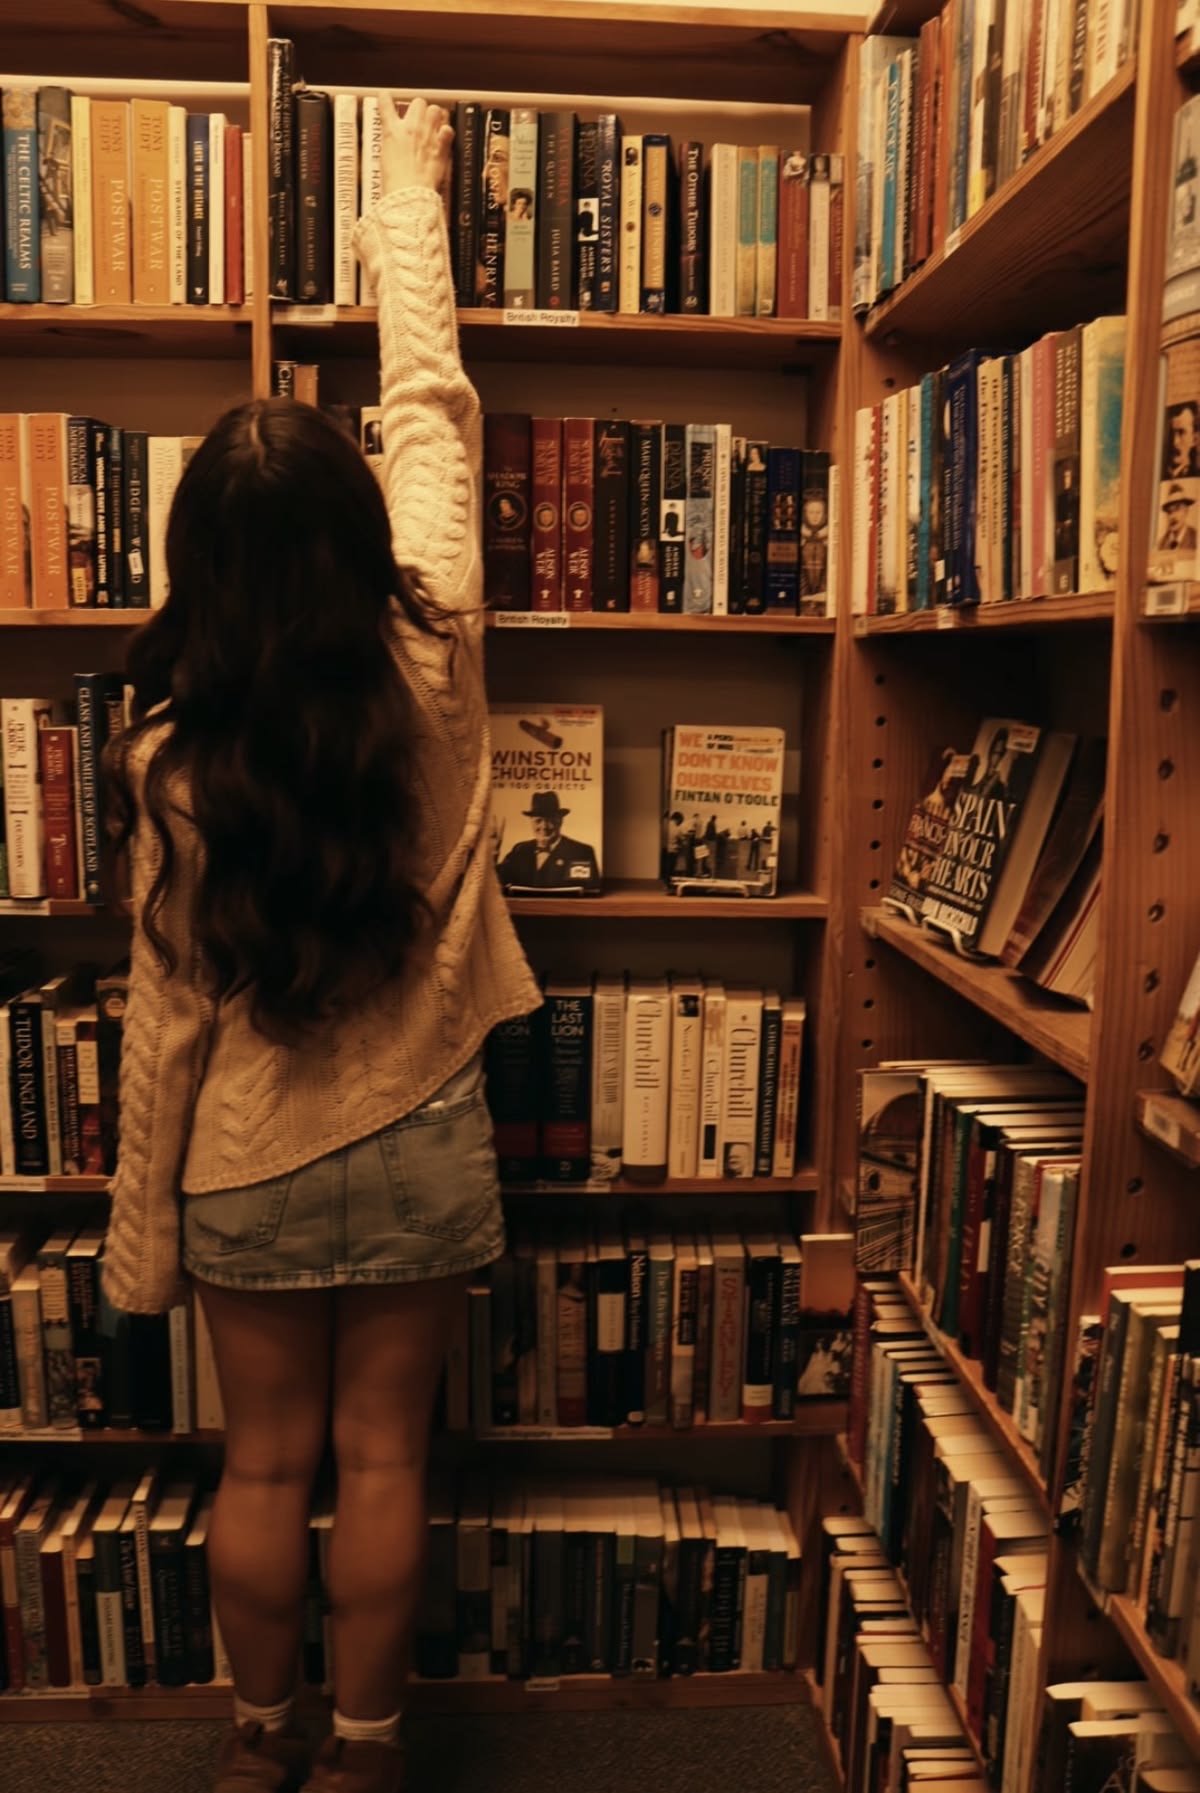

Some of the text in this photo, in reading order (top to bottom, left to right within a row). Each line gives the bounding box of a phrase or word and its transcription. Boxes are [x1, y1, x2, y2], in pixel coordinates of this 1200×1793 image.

[101, 114, 111, 154] JUDT
[112, 115, 123, 154] TONY
[139, 114, 151, 153] JUDT
[152, 115, 163, 153] TONY
[338, 121, 353, 151] ROYAL
[338, 155, 353, 211] MARRIAGES
[546, 134, 558, 199] THE QUEEN
[559, 127, 570, 206] VICTORIA
[583, 138, 595, 189] DIANA
[17, 134, 32, 269] THE CELTIC REALMS
[174, 180, 182, 227] STEWARDS
[487, 160, 501, 210] JONES
[687, 148, 699, 252] THE OTHER TUDORS
[111, 179, 126, 272] POSTWAR
[149, 178, 165, 270] POSTWAR
[175, 230, 182, 241] OF
[601, 163, 613, 274] ROYAL SISTERS
[175, 264, 183, 286] LAND
[486, 233, 500, 285] HENRY
[551, 229, 561, 291] JULIA BAIRD
[540, 313, 576, 324] Royalty
[6, 426, 16, 463] TONY
[35, 426, 45, 463] JUDT
[46, 426, 57, 463] TONY
[70, 426, 78, 485] IMPERIALISM
[78, 426, 87, 484] ECOLOGICAL
[639, 440, 651, 467] MARY
[638, 468, 651, 500] QUEEN
[668, 441, 681, 490] DIANA
[129, 480, 142, 513] EDGE
[4, 486, 19, 576] POSTWAR
[47, 486, 61, 576] POSTWAR
[535, 551, 546, 576] WEIR
[546, 548, 557, 580] ALISON
[568, 551, 579, 576] WEIR
[579, 548, 590, 580] ALISON
[532, 614, 567, 626] Royalty
[8, 718, 17, 758] ACKROYD
[17, 722, 27, 752] PETER
[679, 732, 704, 748] WE
[491, 750, 592, 767] WINSTON
[678, 752, 779, 772] DON'T KNOW
[77, 687, 98, 873] CLANS AND FAMILIES OF SCOTLAND
[535, 783, 587, 791] OBJECTS
[673, 789, 780, 807] FINTAN O'TOOLE
[676, 772, 773, 791] OURSELVES
[947, 792, 1017, 841] SPAIN
[14, 819, 24, 869] FOUNDATION
[959, 834, 997, 869] OUR
[928, 856, 993, 901] HEARTS
[551, 1012, 584, 1024] LAST
[556, 1000, 581, 1011] THE
[551, 1025, 585, 1037] LION
[603, 1002, 621, 1062] CHURCHILL'S
[634, 1000, 664, 1089] Churchill
[15, 1018, 38, 1140] TUDOR ENGLAND
[703, 1059, 721, 1122] Churchill
[727, 1028, 758, 1118] Churchill
[761, 1024, 777, 1154] CHURCHILL ON LEADERSHIP
[630, 1256, 646, 1298] Nelson
